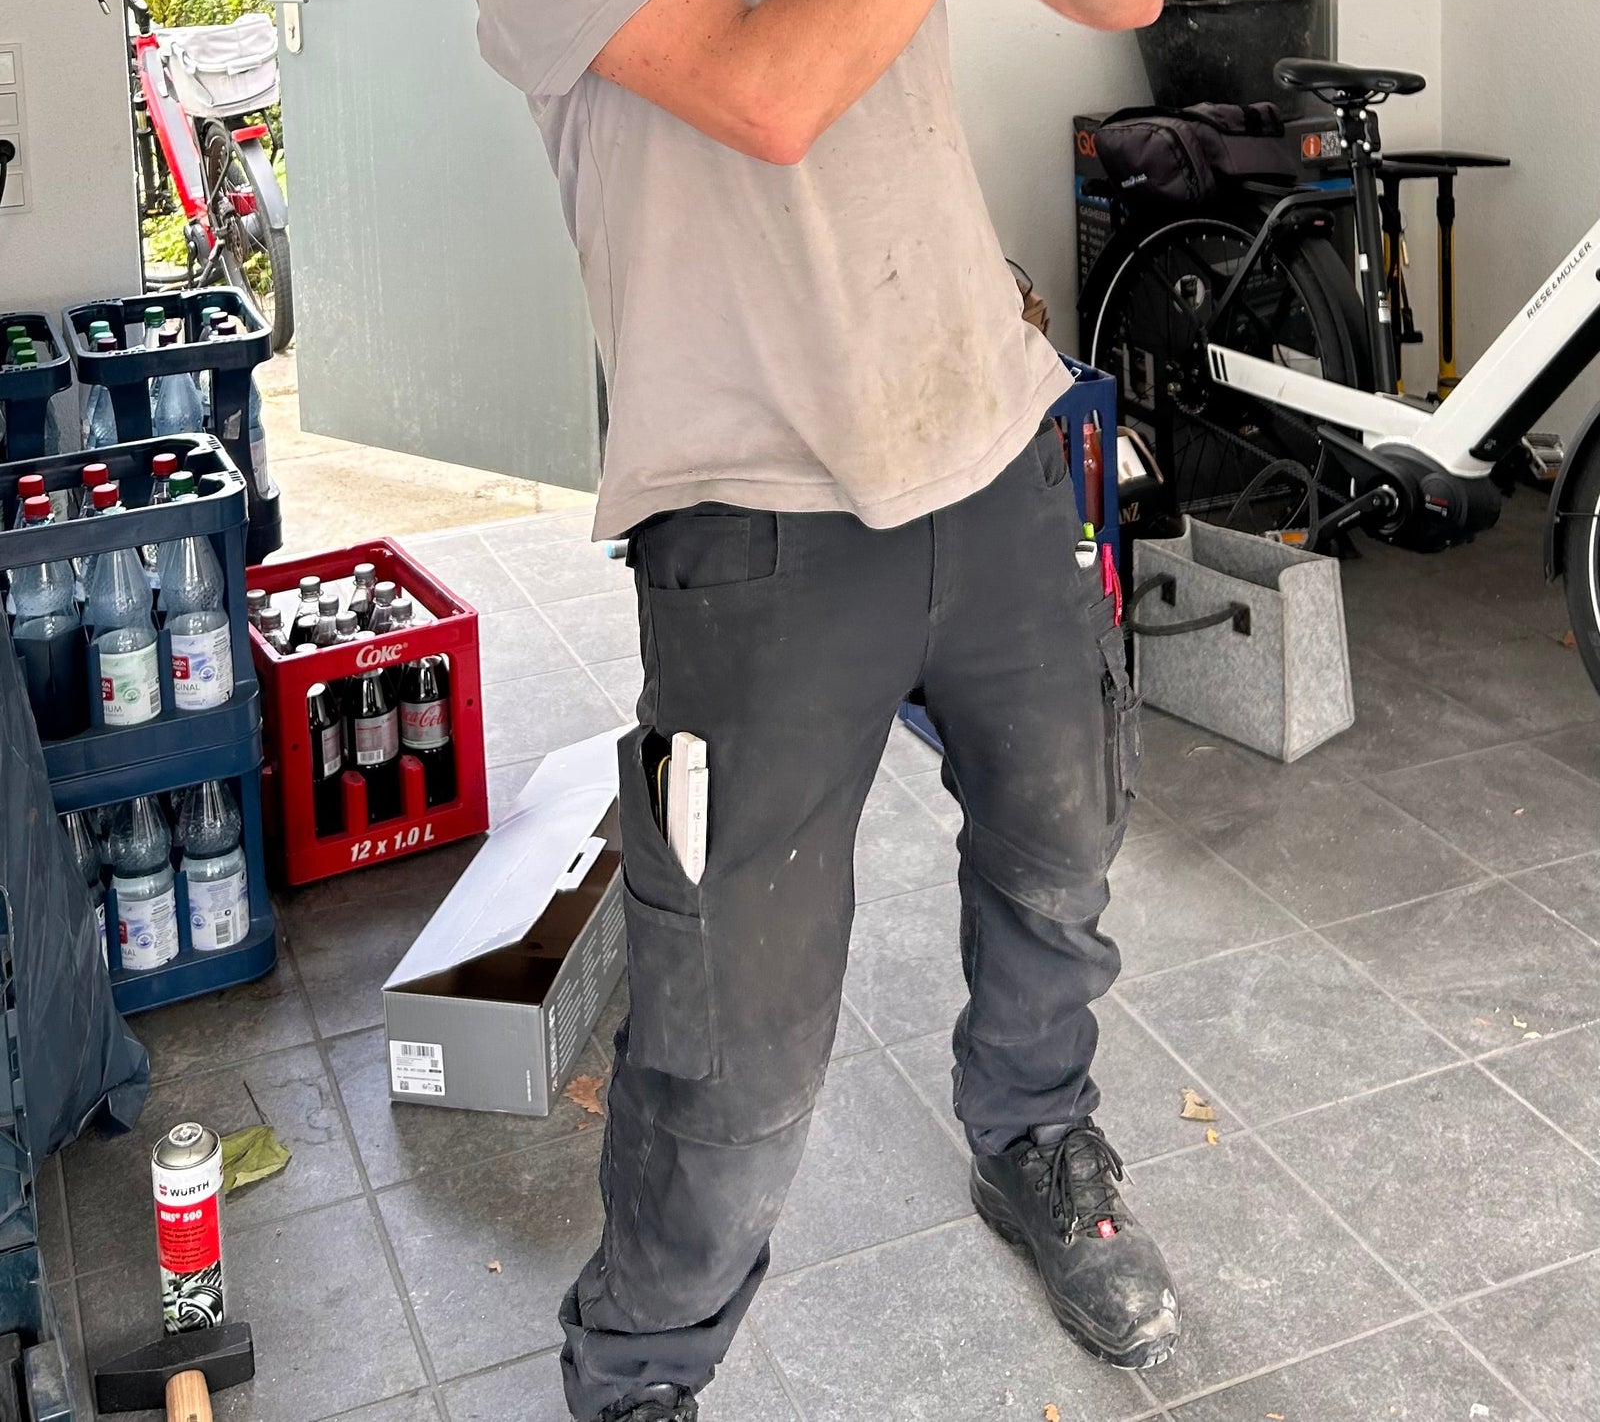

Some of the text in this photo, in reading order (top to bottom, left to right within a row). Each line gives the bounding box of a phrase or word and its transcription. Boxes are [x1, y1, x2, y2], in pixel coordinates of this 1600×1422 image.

[1526, 286, 1552, 319] RIESE
[174, 683, 201, 692] GINAL
[351, 823, 435, 862] 12 x 1.0 L
[182, 1209, 203, 1223] 500
